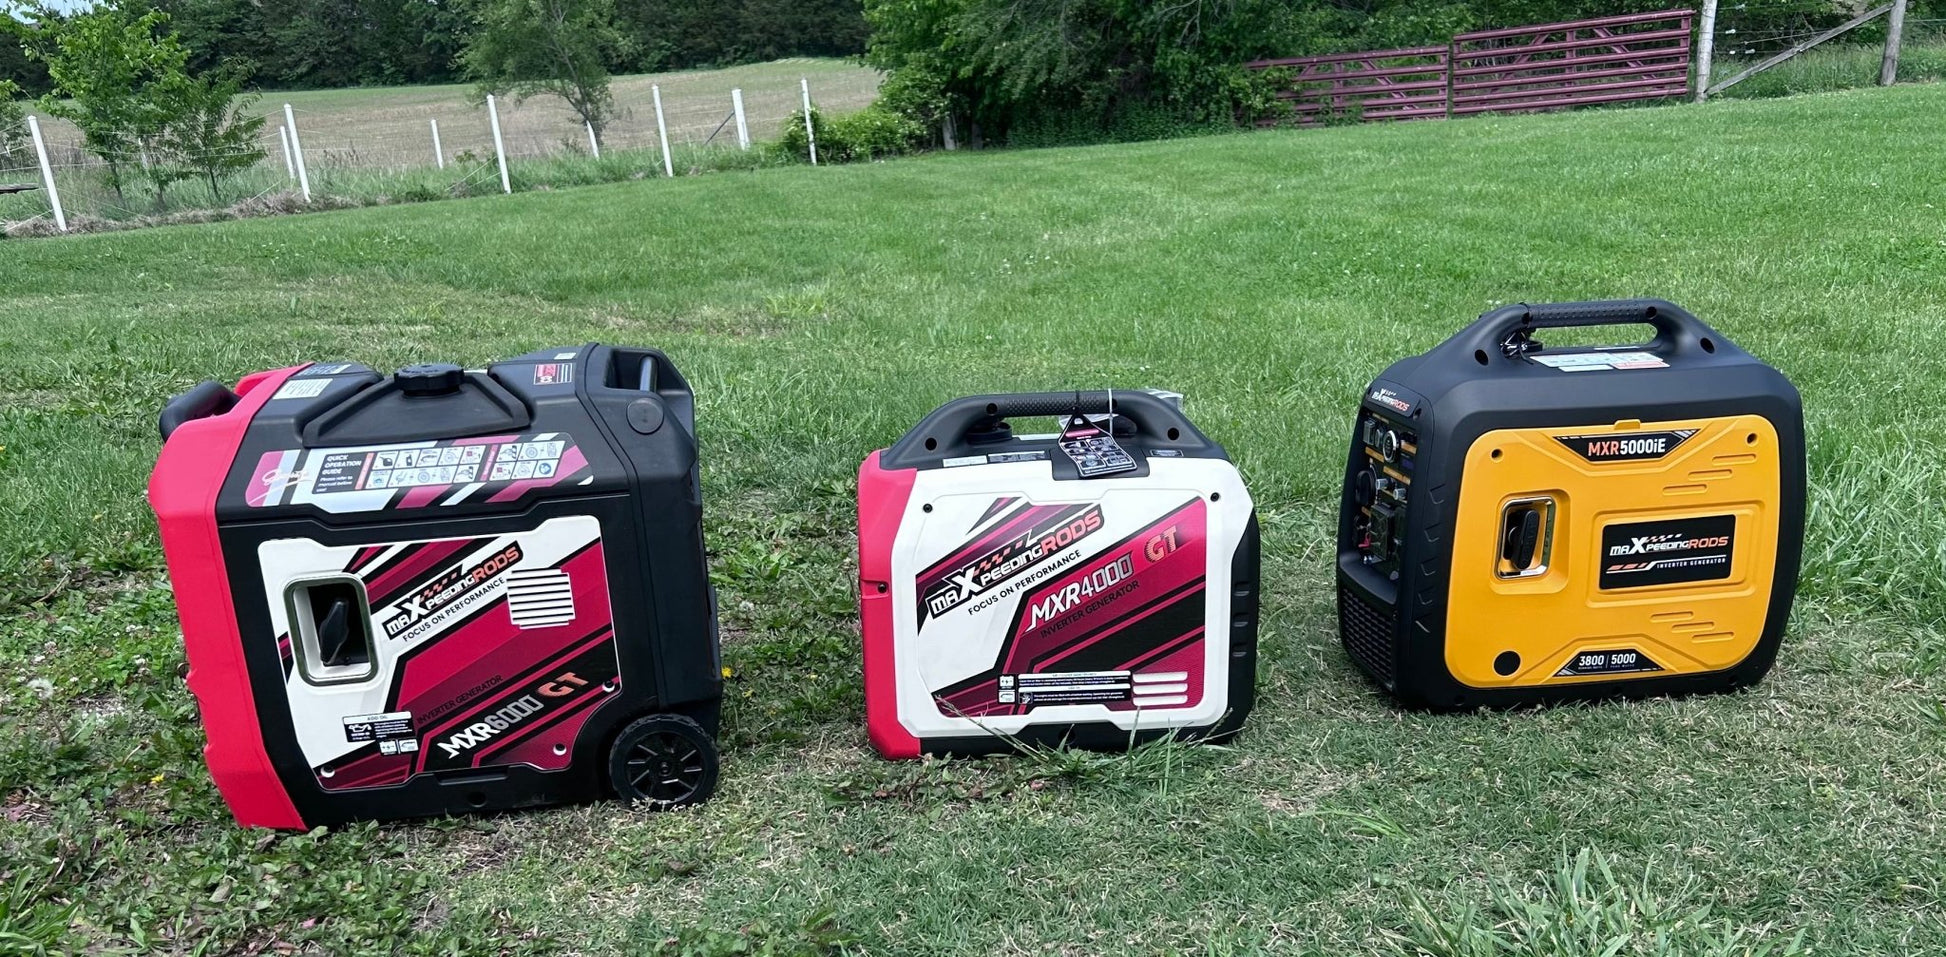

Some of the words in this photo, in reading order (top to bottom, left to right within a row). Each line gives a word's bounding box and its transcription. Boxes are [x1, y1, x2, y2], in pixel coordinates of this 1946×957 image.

[324, 460, 362, 468] OPERATION
[326, 454, 349, 462] QUICK
[1587, 438, 1666, 457] MXR5000iE
[968, 594, 999, 616] FOCUS
[999, 586, 1014, 598] ON
[1014, 549, 1082, 591] PERFORMANCE
[1024, 552, 1134, 633] MXR4000
[1144, 525, 1177, 563] GT
[1656, 561, 1688, 569] INVERTER
[1689, 557, 1726, 566] GENERATOR
[402, 621, 431, 642] FOCUS
[431, 613, 446, 624] ON
[446, 577, 506, 618] PERFORMANCE
[1040, 608, 1084, 639] INVERTER
[1085, 580, 1140, 615] GENERATOR
[1578, 654, 1605, 666] 3800
[1610, 653, 1637, 665] 5000
[416, 700, 456, 725] INVERTER
[455, 674, 503, 704] GENERATOR
[436, 694, 545, 759] MXR6000
[536, 671, 589, 697] GT
